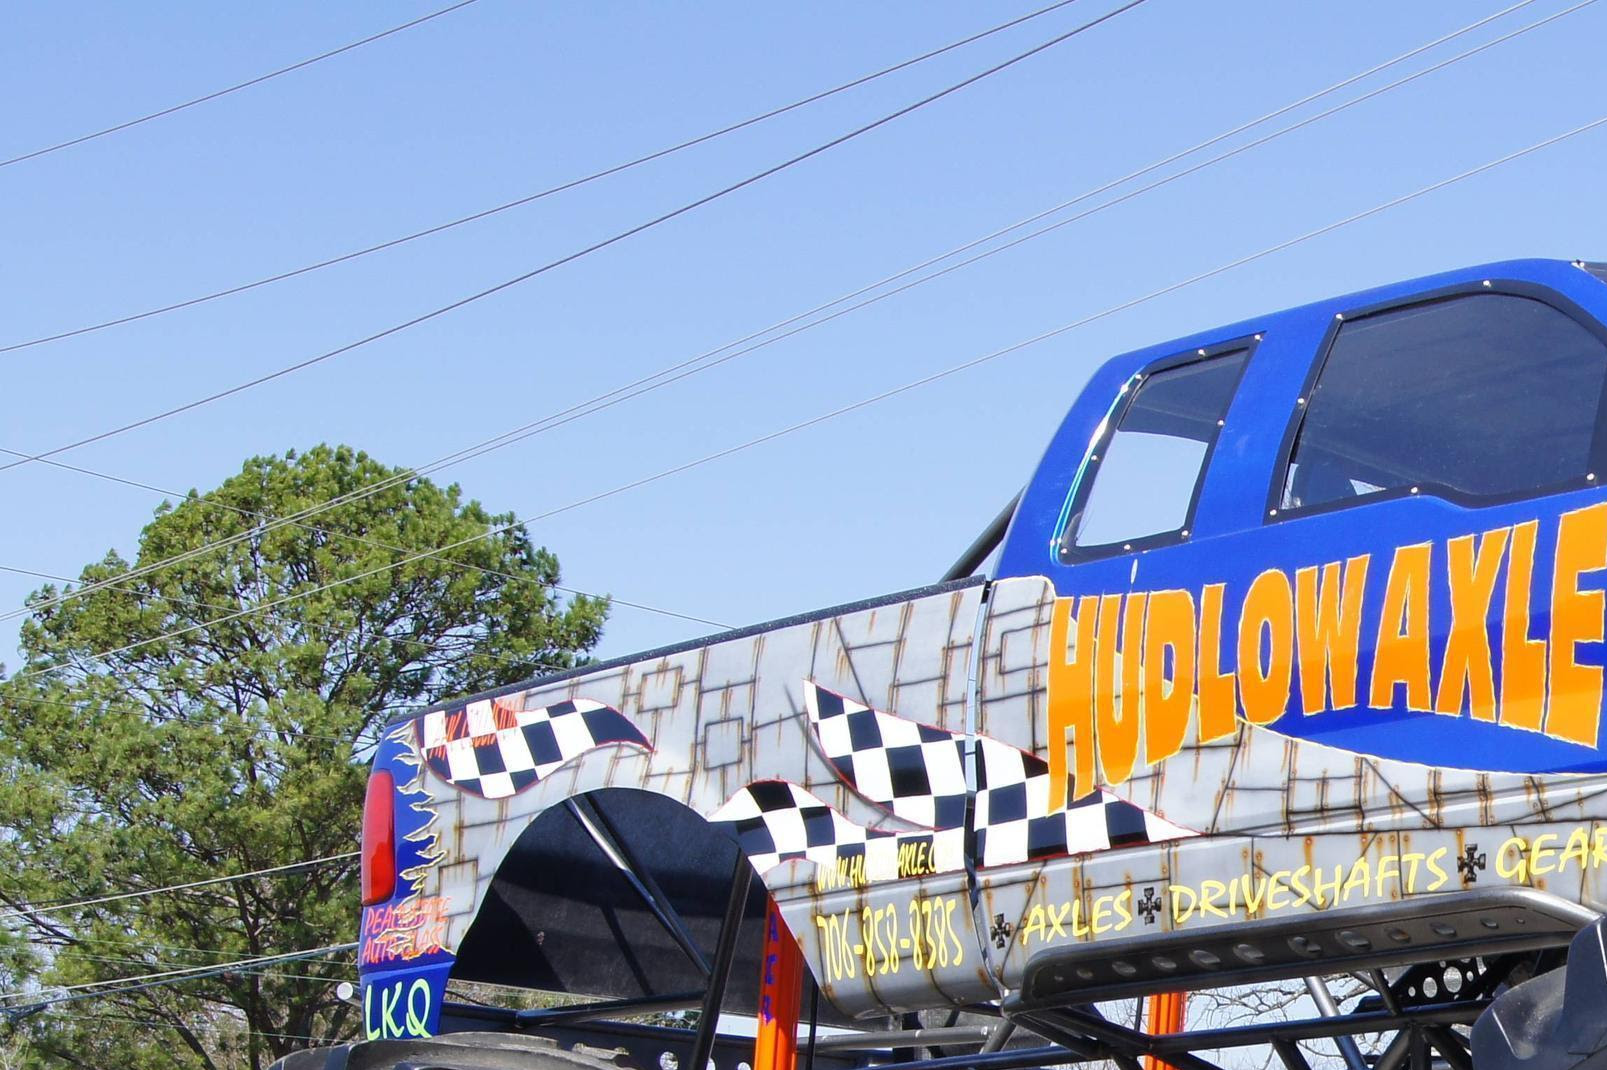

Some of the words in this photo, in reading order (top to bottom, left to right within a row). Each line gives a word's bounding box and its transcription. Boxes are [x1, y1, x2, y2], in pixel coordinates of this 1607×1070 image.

[1045, 552, 1370, 816] HUDLOW
[816, 895, 964, 984] 706-858-8385
[1021, 888, 1133, 945] AXLES
[1168, 846, 1449, 925] DRIVESHAFTS
[365, 977, 432, 1041] LKQ
